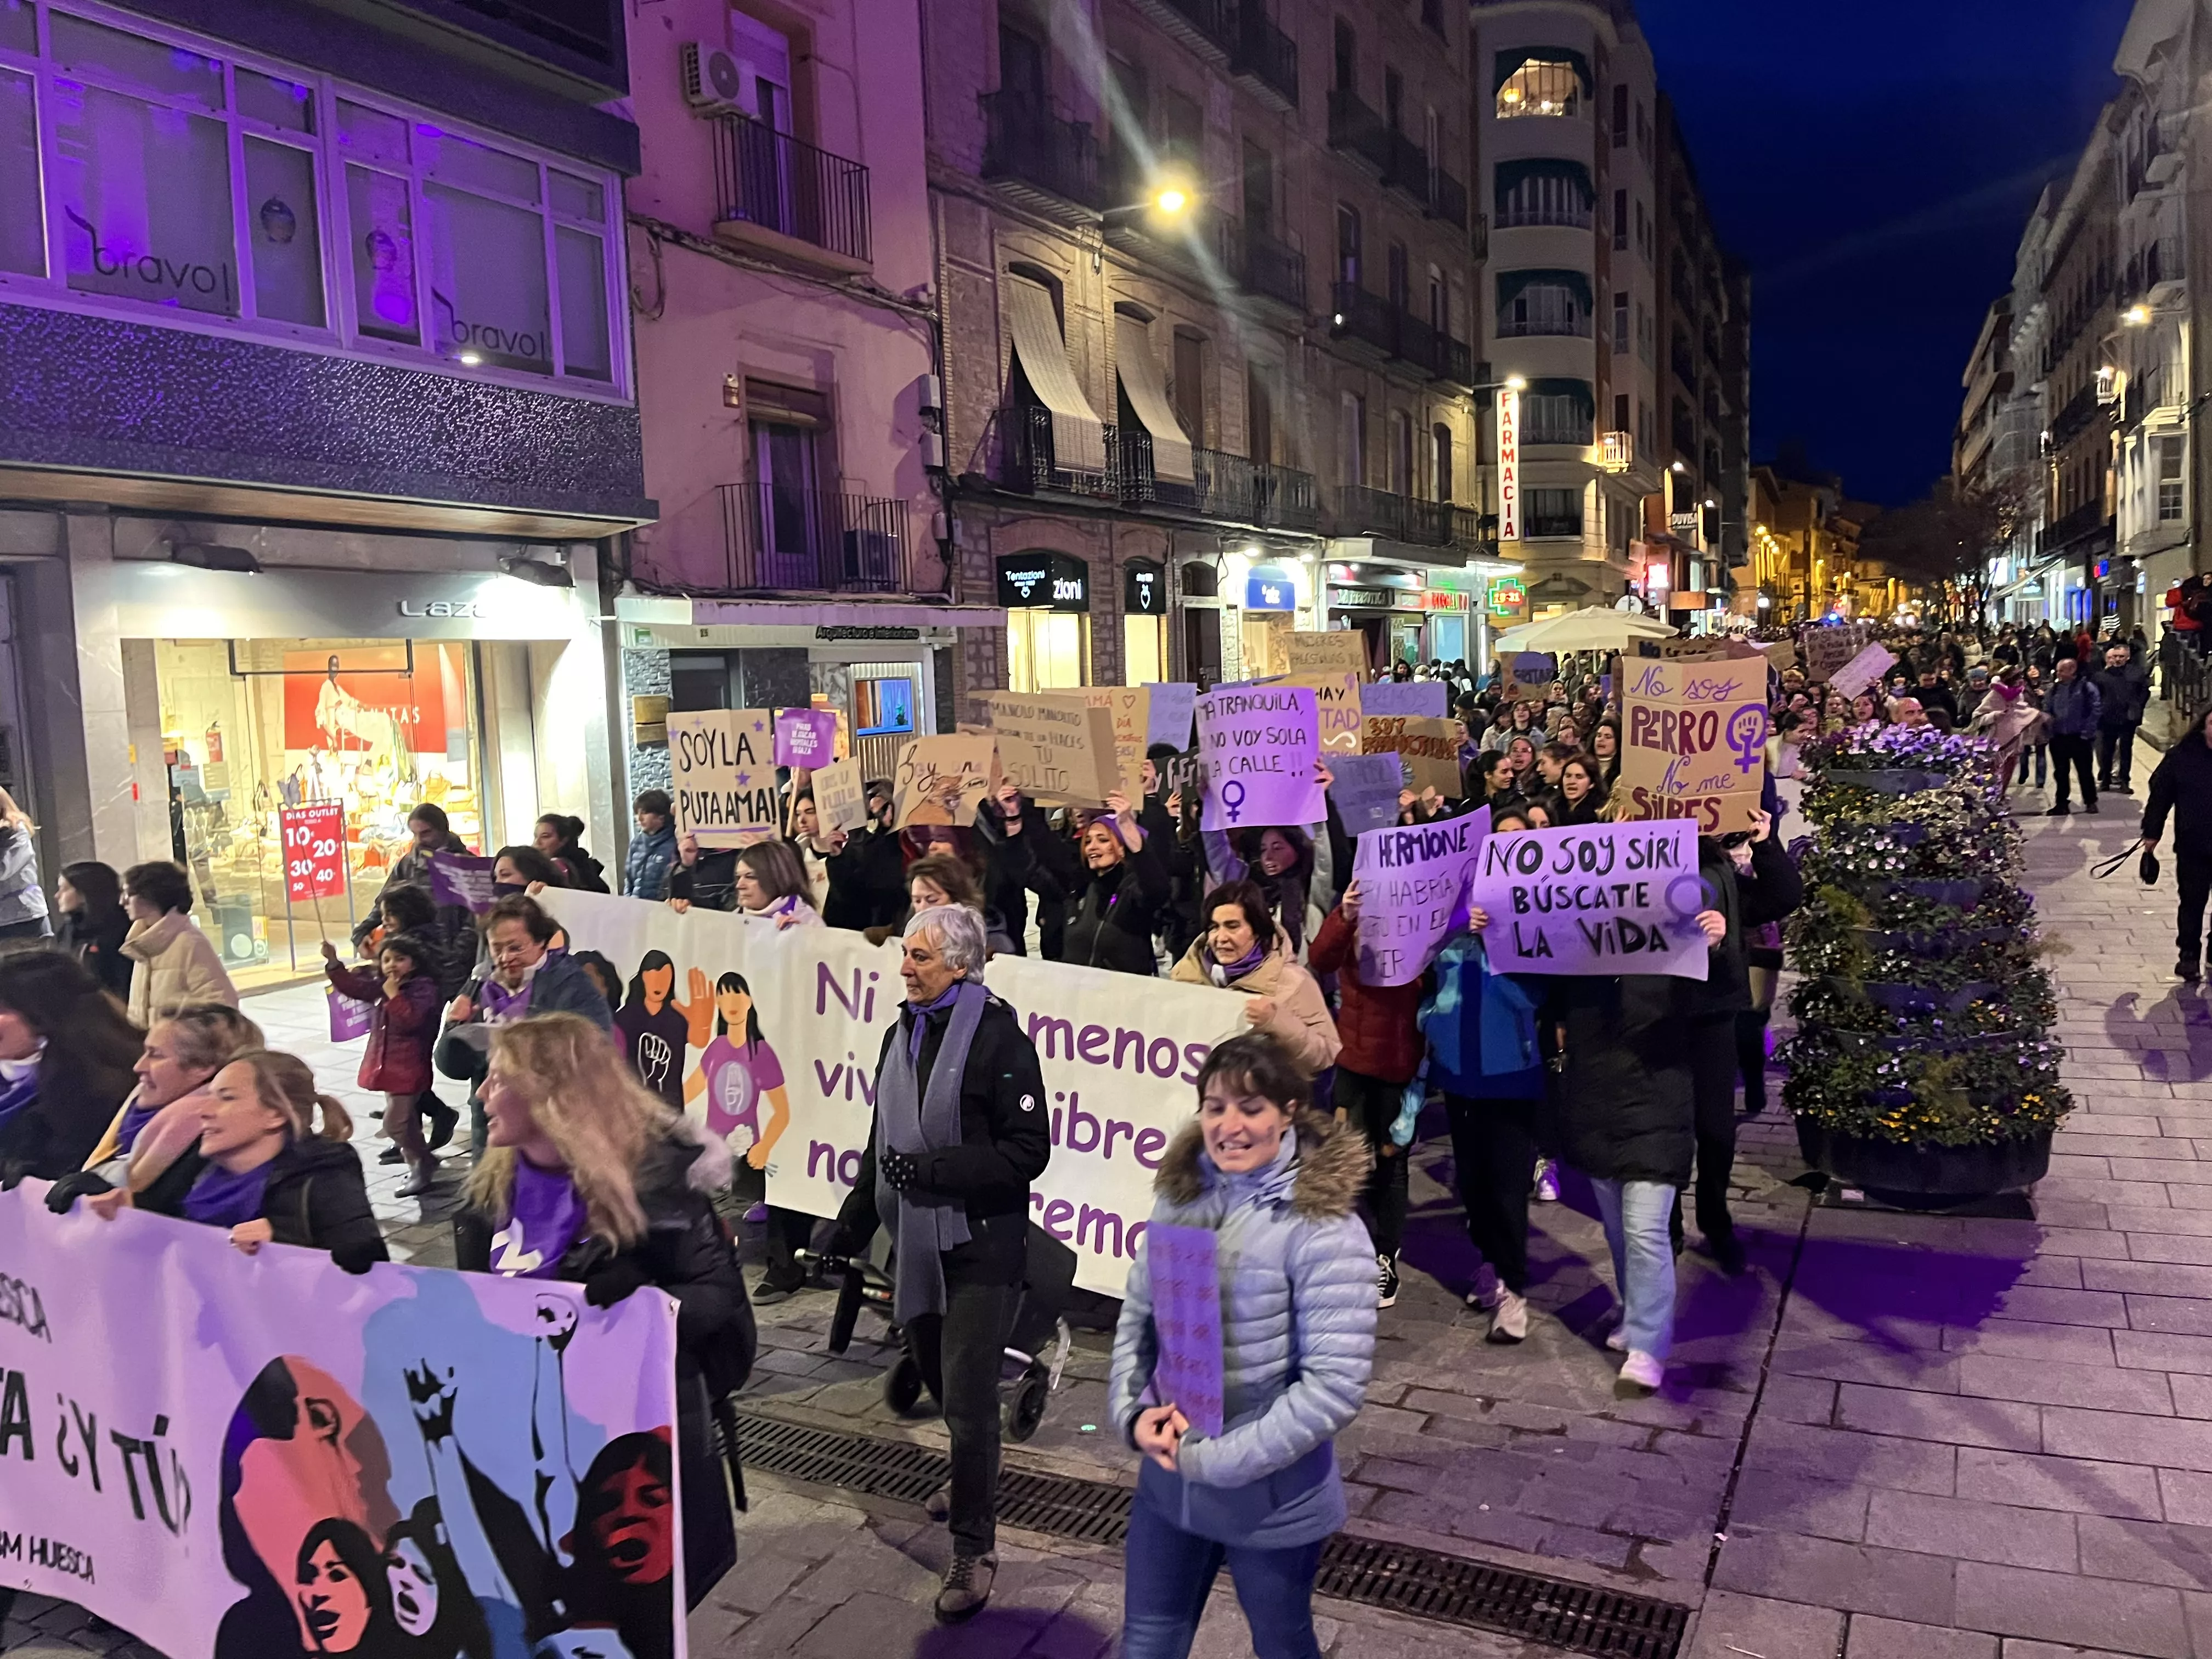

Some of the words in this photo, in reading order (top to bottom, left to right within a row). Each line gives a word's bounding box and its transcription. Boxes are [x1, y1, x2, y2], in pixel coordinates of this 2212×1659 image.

[1500, 392, 1515, 538] FARMACIA
[1053, 577, 1084, 600] zioni
[1630, 665, 1674, 697] No
[1681, 676, 1743, 701] soy
[680, 727, 716, 772] SOY
[721, 732, 756, 766] LA
[1233, 729, 1261, 746] VOY
[1266, 726, 1306, 744] SOLA
[1630, 705, 1719, 756] PERRO
[1656, 755, 1691, 795] No
[1696, 773, 1735, 793] me
[308, 808, 338, 818] OUTLET
[680, 789, 723, 833] PUTA
[725, 786, 777, 825] AMA!
[1484, 836, 1543, 877] NO
[1552, 834, 1615, 877] SOY
[1511, 874, 1650, 915] BÚSCATE
[1511, 921, 1554, 959] LA
[816, 961, 880, 1024] Ni
[1027, 1012, 1212, 1086] menos
[57, 1392, 103, 1493] ¿Y
[30, 1536, 95, 1585] HUESCA
